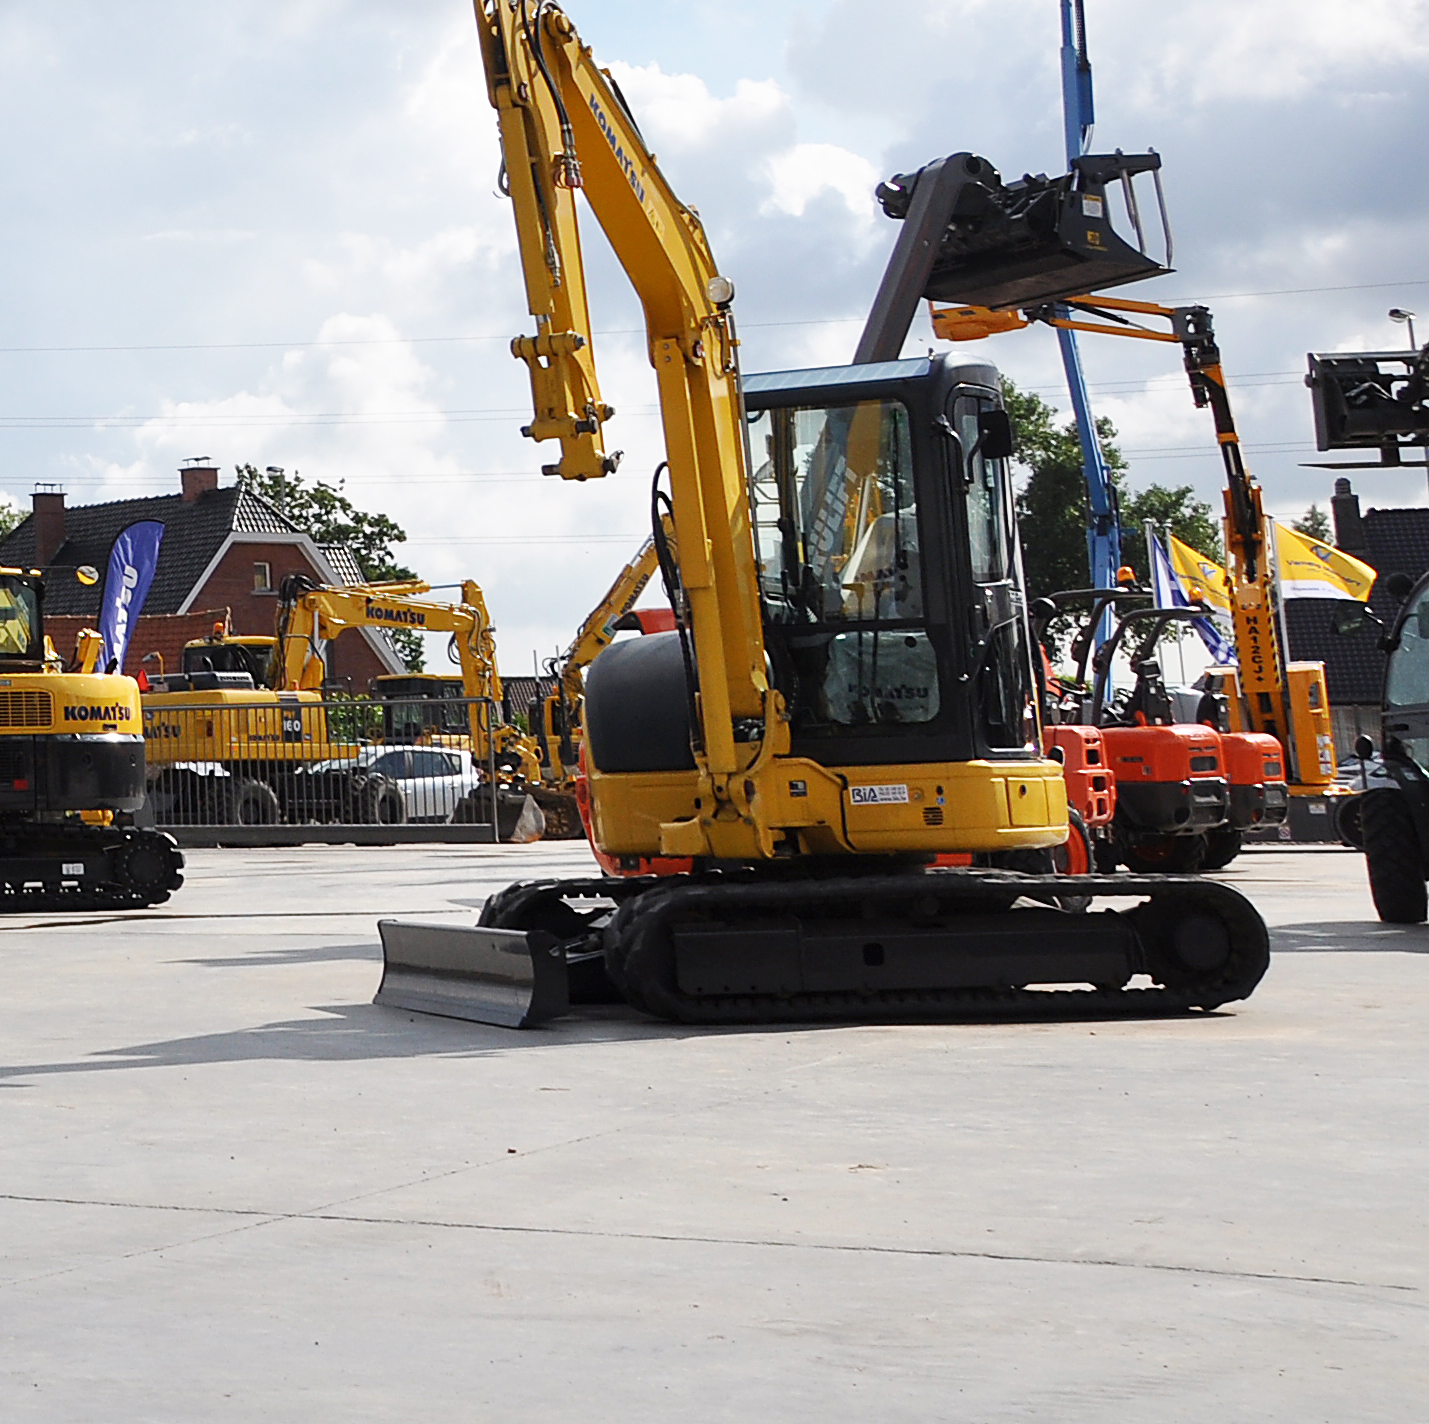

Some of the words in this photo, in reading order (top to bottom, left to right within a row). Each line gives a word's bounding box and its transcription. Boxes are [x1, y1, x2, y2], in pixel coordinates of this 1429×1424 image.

[589, 93, 645, 203] KOMATSU
[366, 606, 426, 625] KOMATSU
[63, 702, 132, 722] KOMATSU
